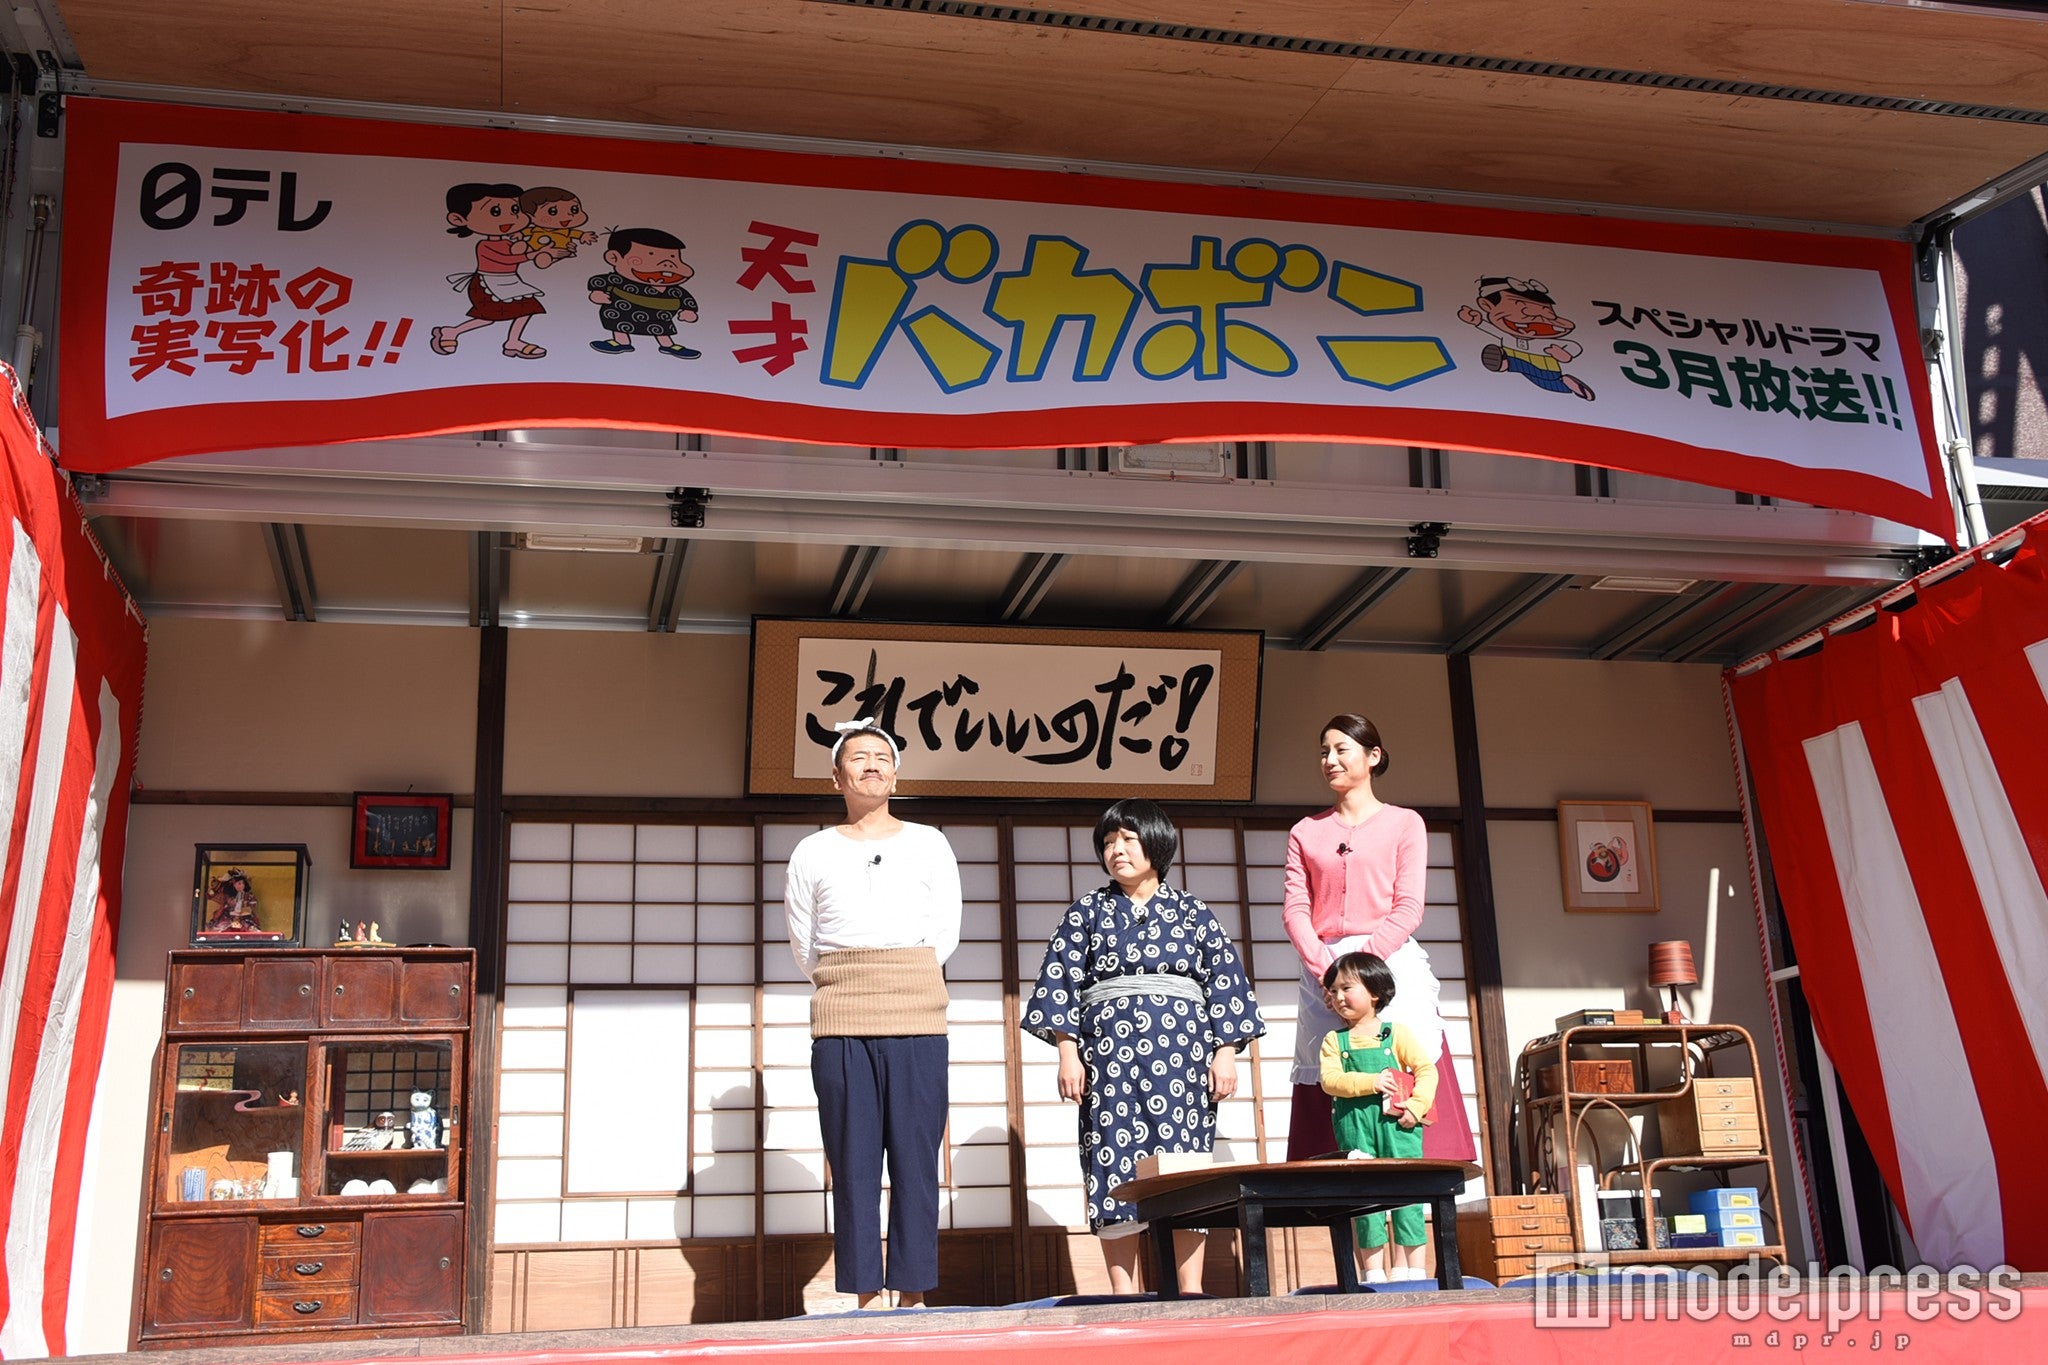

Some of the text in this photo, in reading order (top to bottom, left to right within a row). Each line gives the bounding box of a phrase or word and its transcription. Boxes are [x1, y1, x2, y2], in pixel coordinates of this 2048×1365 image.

[131, 260, 353, 317] 奇跡の
[728, 220, 819, 376] 天才
[820, 218, 1457, 394] バカボン
[1590, 300, 1882, 362] スペシャルドラマ
